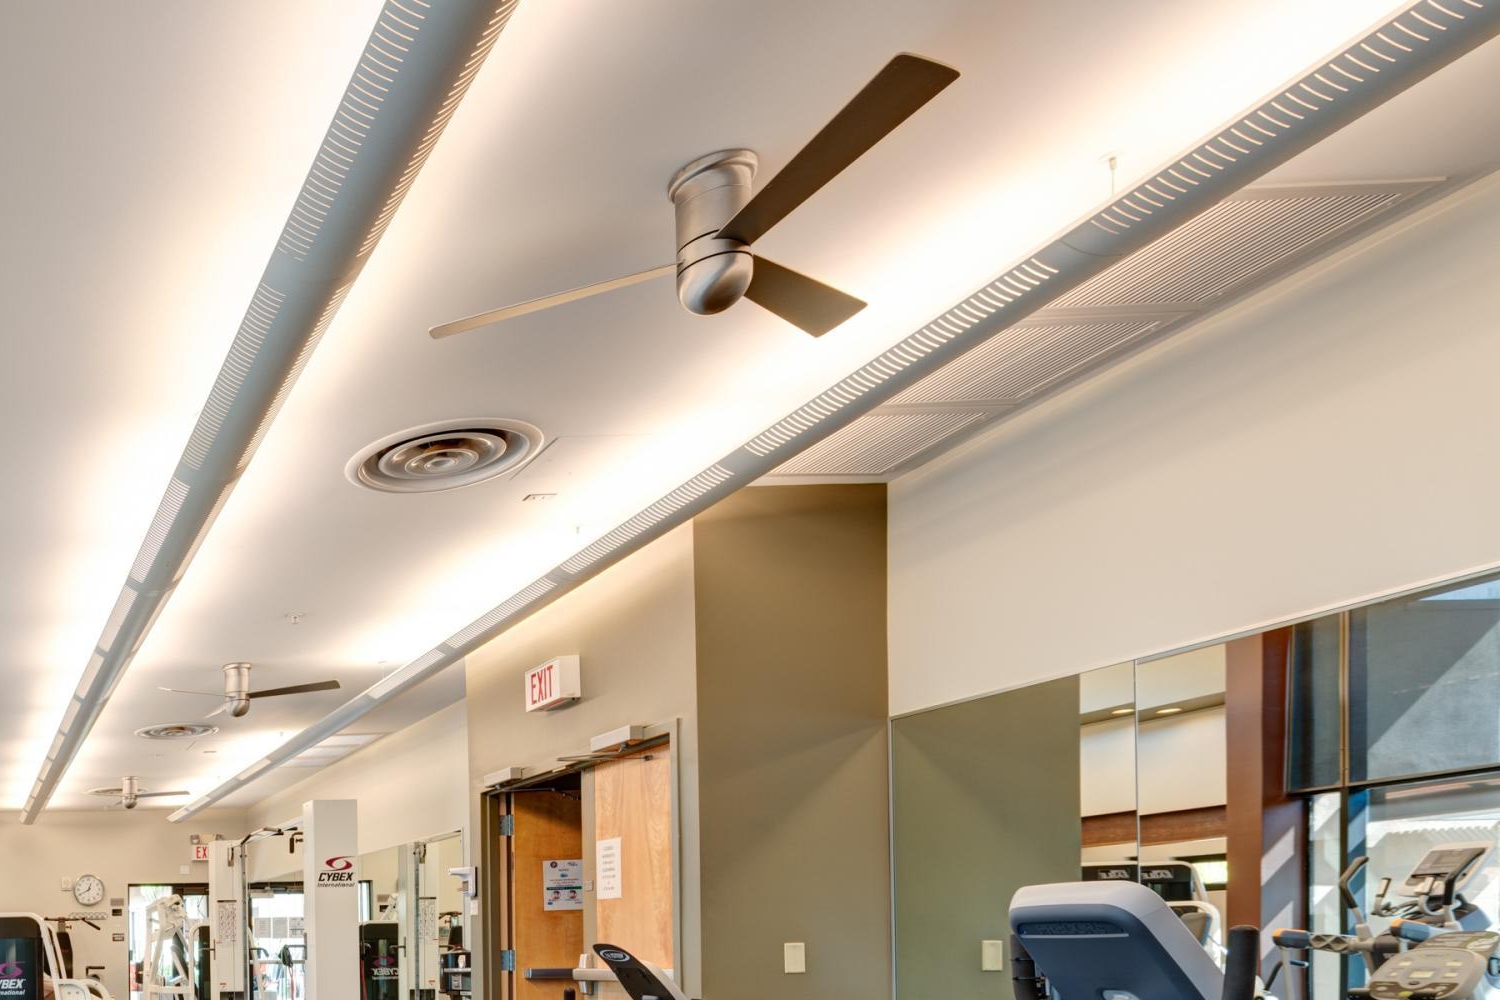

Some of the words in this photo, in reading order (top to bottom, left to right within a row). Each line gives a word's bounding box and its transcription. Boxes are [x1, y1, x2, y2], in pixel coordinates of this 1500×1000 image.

[531, 665, 553, 705] EXIT
[196, 846, 208, 859] EX
[318, 872, 354, 882] CYBEX
